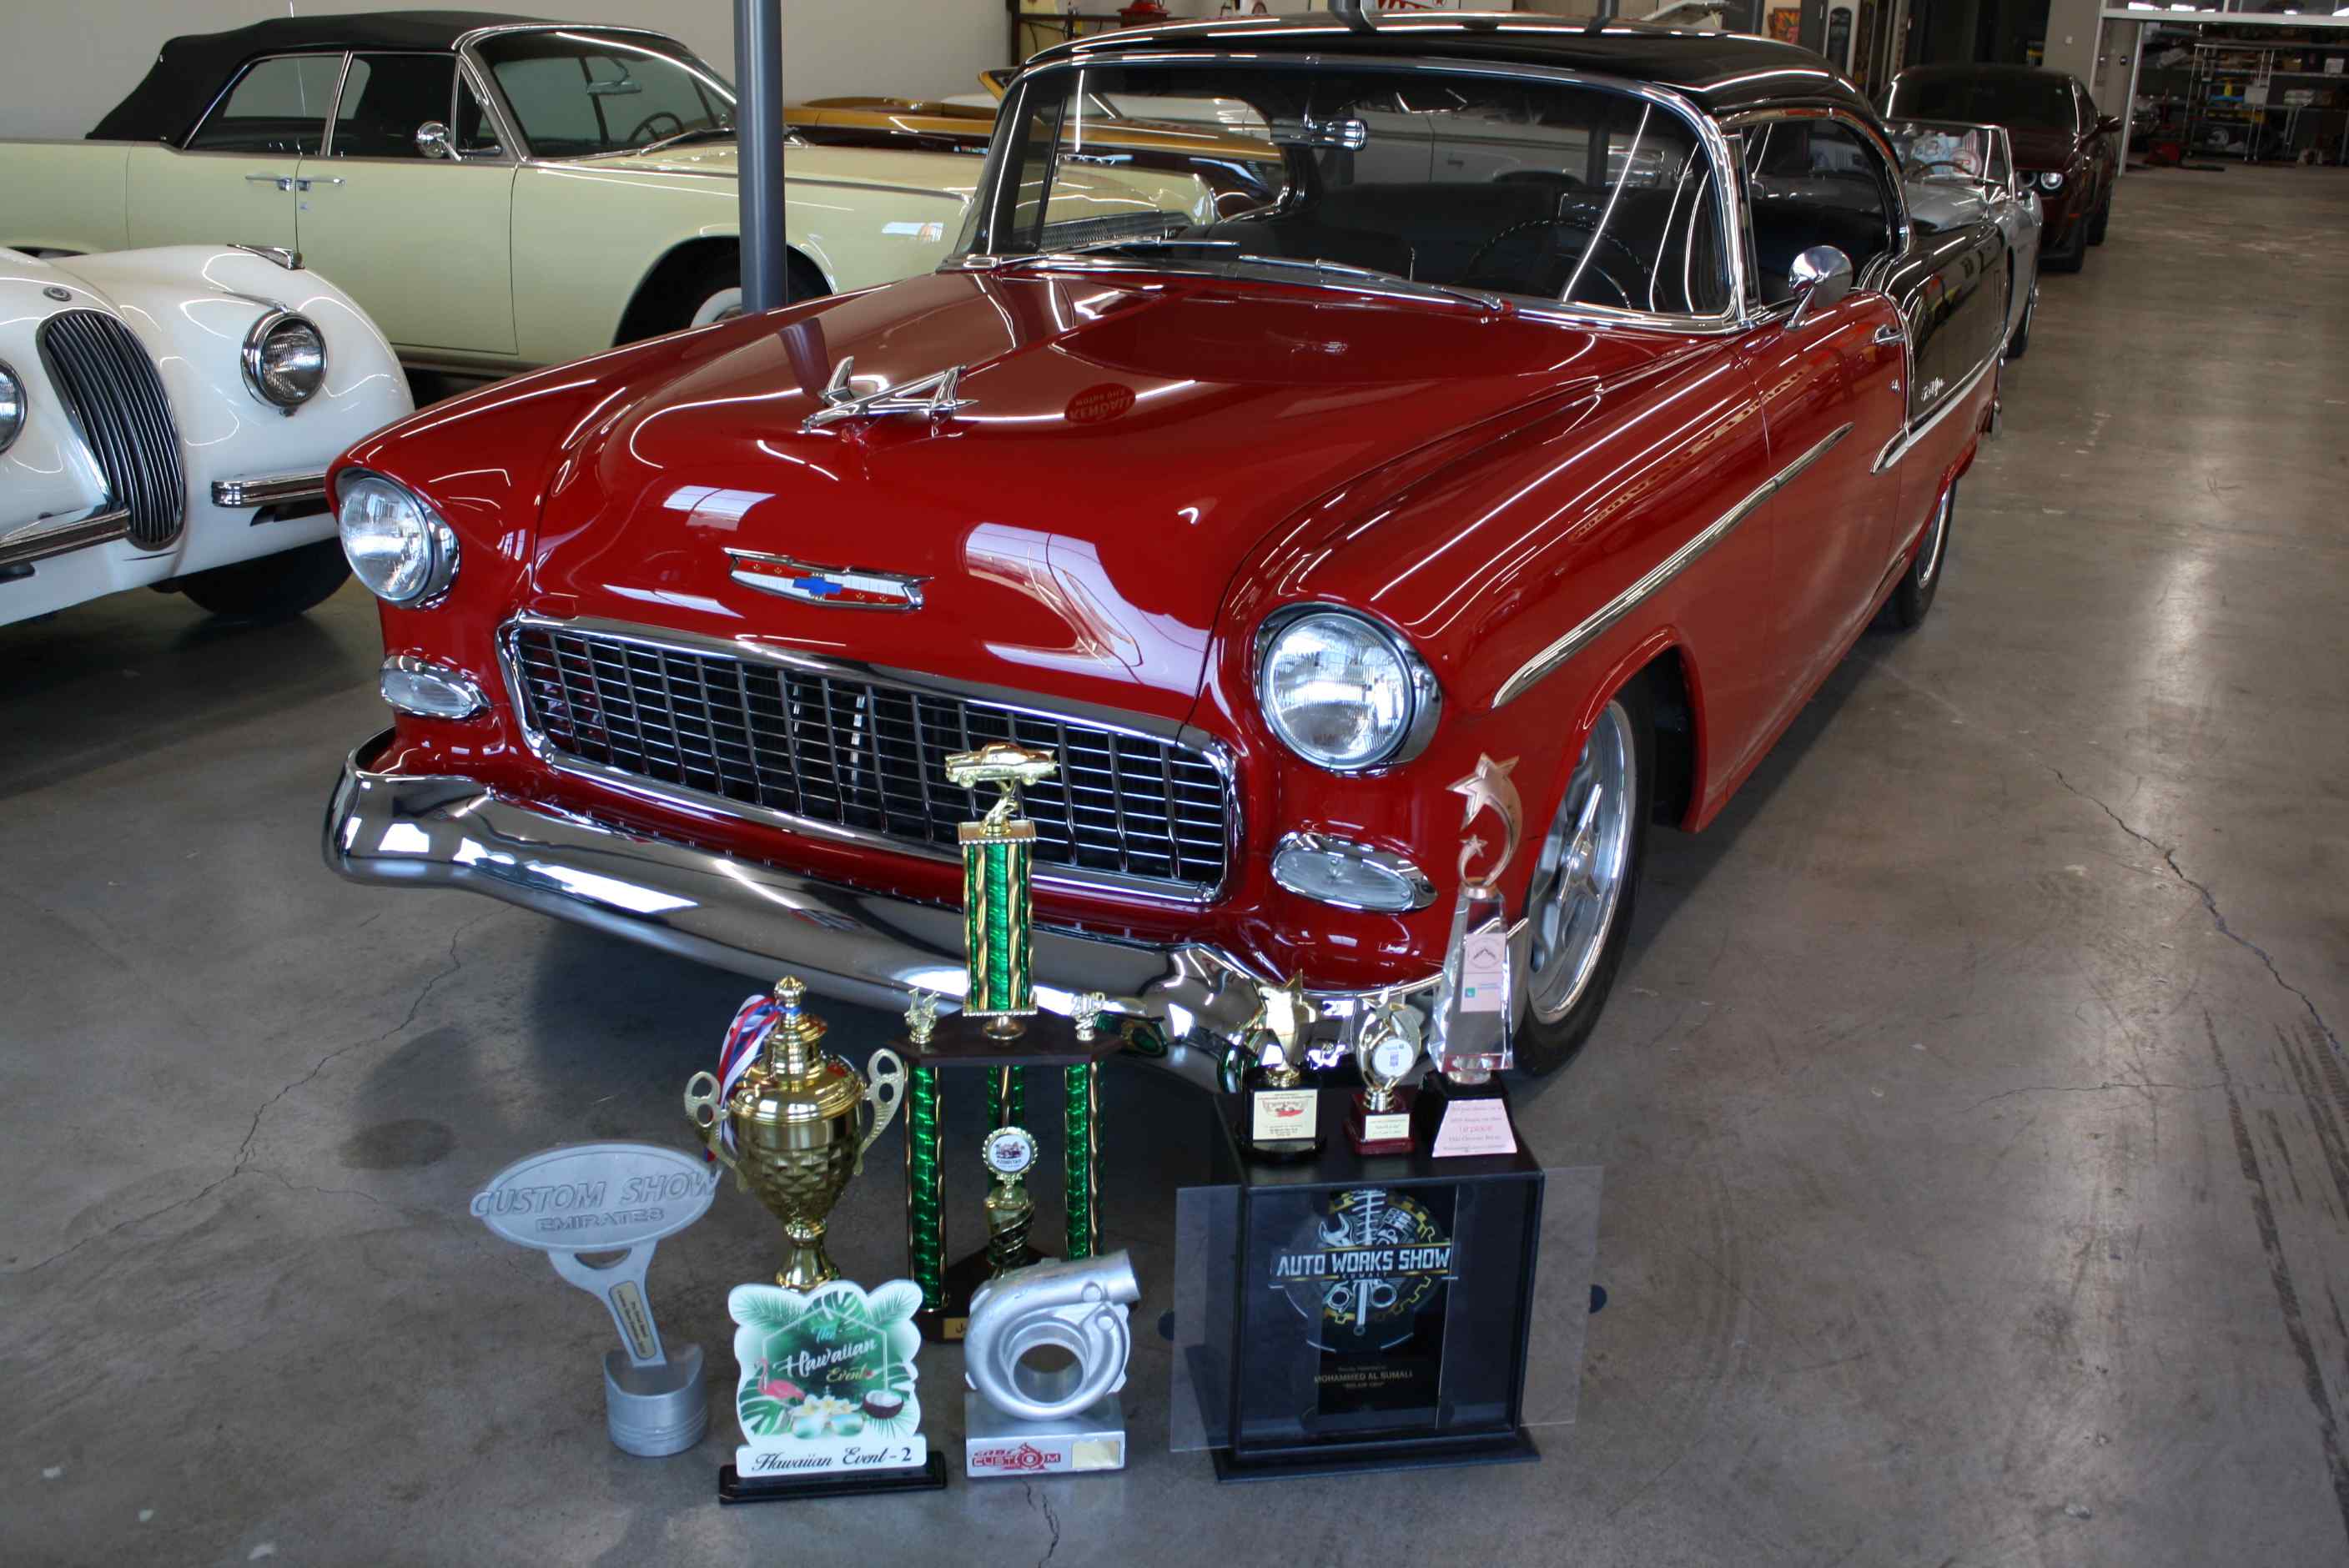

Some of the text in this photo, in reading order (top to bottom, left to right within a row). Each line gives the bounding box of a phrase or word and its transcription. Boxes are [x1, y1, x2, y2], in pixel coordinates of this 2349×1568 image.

[470, 1168, 722, 1216] CUSTOM SHOW
[536, 1208, 665, 1232] EMIRATES
[1276, 1248, 1451, 1277] AUTO WORKS SHOW
[773, 1338, 876, 1377] Hawaiian
[826, 1364, 868, 1383] Event
[752, 1452, 832, 1471] Hawaiian
[843, 1447, 888, 1465] Event
[902, 1447, 912, 1462] 2
